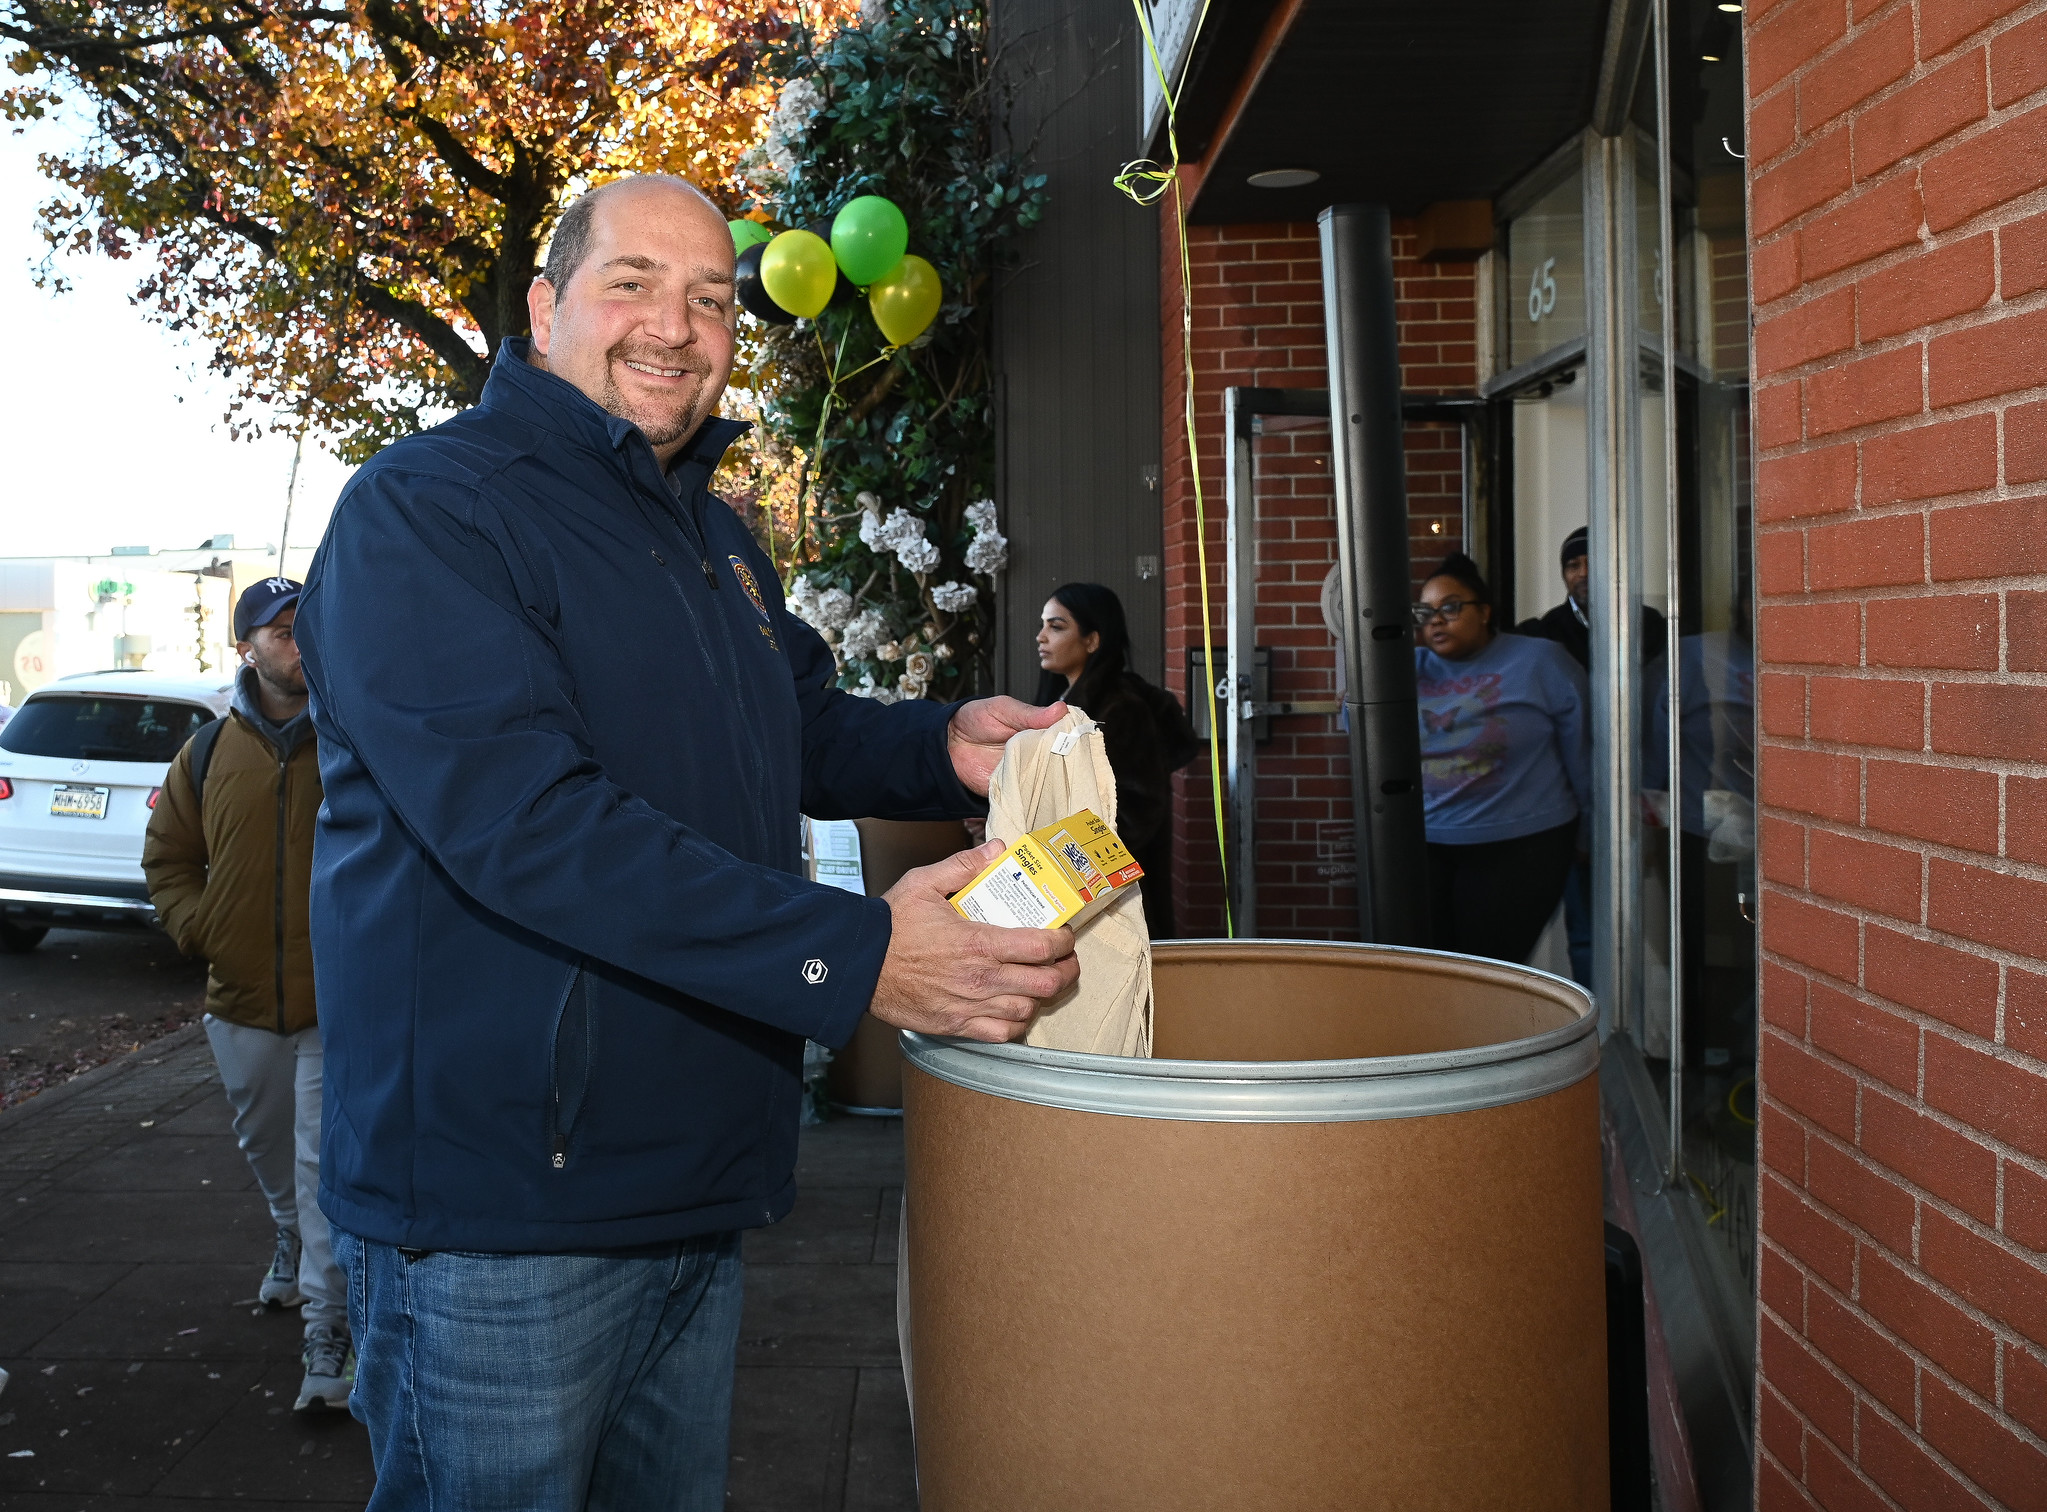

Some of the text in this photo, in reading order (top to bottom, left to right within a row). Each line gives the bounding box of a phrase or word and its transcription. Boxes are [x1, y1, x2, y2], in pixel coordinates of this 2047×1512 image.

[1528, 257, 1556, 322] 65
[266, 577, 294, 594] NY
[1015, 848, 1038, 876] Singles
[1021, 844, 1043, 870] Pocket Size
